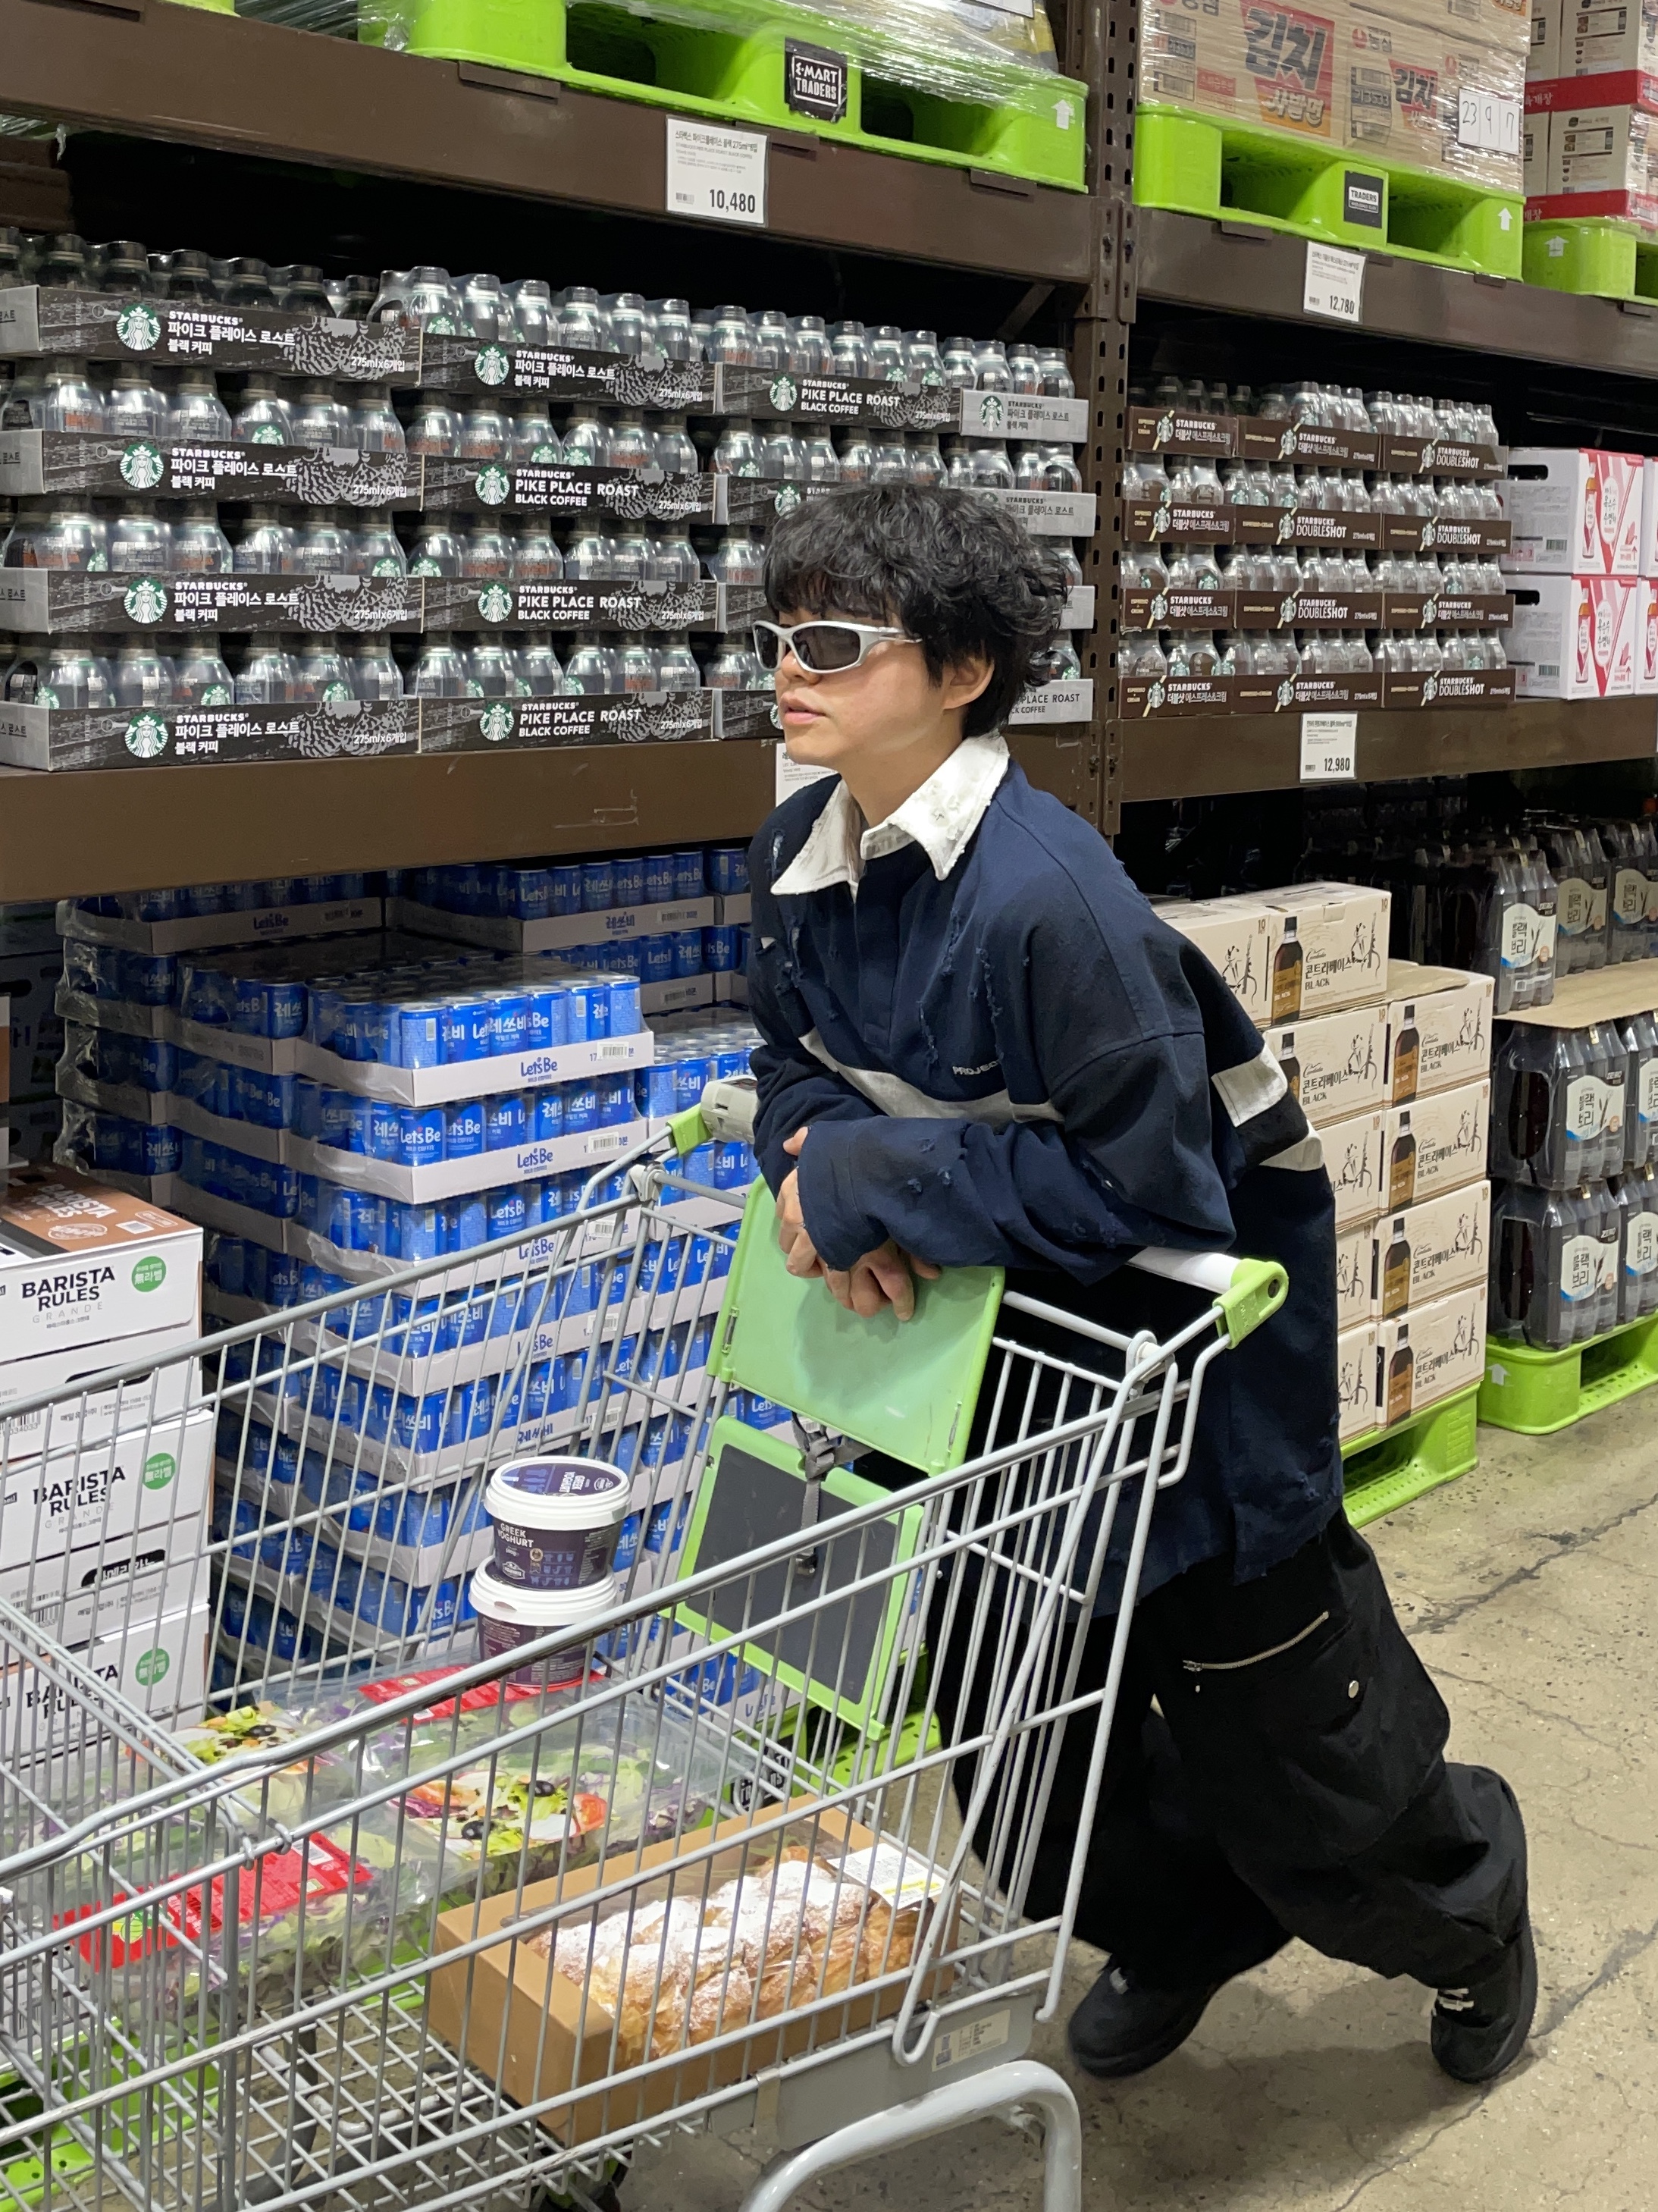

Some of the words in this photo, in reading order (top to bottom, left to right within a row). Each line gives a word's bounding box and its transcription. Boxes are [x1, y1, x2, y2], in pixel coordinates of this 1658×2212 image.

[1246, 8, 1327, 92] 김치
[795, 78, 837, 101] TRADERS
[1393, 68, 1436, 110] 김치
[1263, 89, 1324, 127] 사발면
[1462, 100, 1477, 126] 23
[710, 189, 755, 213] 10,480
[1351, 190, 1377, 202] TRADERS
[1330, 295, 1355, 315] 12,780
[168, 311, 243, 325] STARBUCKS
[168, 322, 206, 337] 파이크
[209, 325, 256, 342] 플레이스
[260, 332, 296, 346] 로스트
[168, 338, 190, 353] 블랙
[191, 341, 212, 355] 커피
[516, 350, 575, 362] STARBUCKS
[515, 360, 544, 374] 파이크
[547, 362, 585, 378] 플레이스
[587, 367, 615, 380] 로스트
[532, 376, 550, 388] 커피
[802, 379, 849, 391] STARBUCKS
[801, 388, 825, 402] PIKE
[829, 391, 863, 405] PLACE
[866, 394, 900, 407] ROAST
[1008, 400, 1045, 409] STARBUCKS
[801, 400, 828, 413] BLACK
[830, 403, 860, 416] COFFEE
[1175, 419, 1215, 430] STARBUCKS
[1299, 433, 1336, 444] STARBUCKS
[171, 448, 246, 460] STARBUCKS
[1437, 447, 1470, 457] STARBUCKS
[171, 458, 208, 474] 파이크
[211, 460, 259, 476] 플레이스
[262, 464, 298, 478] 로스트
[1436, 454, 1479, 469] DOUBLESHOT
[516, 469, 575, 479] STARBUCKS
[171, 475, 193, 489] 블랙
[194, 476, 215, 490] 커피
[516, 480, 546, 492] PIKE
[549, 481, 591, 494] PLACE
[597, 483, 638, 497] ROAST
[516, 494, 548, 505] BLACK
[551, 494, 588, 507] COFFEE
[1173, 510, 1215, 519] STARBUCKS
[1297, 516, 1335, 526] STARBUCKS
[1296, 525, 1346, 538] DOUBLESHOT
[1437, 532, 1481, 544] DOUBLESHOT
[175, 581, 247, 591] STARBUCKS
[519, 585, 578, 595] STARBUCKS
[174, 591, 212, 607] 파이크
[215, 591, 262, 607] 플레이스
[264, 593, 300, 606] 로스트
[518, 595, 549, 608] PIKE
[552, 595, 594, 608] PLACE
[600, 596, 641, 608] ROAST
[1171, 596, 1212, 604] STARBUCKS
[174, 607, 196, 622] 블랙
[197, 607, 218, 622] 커피
[518, 609, 551, 620] BLACK
[553, 610, 591, 620] COFFEE
[1298, 607, 1348, 619] DOUBLESHOT
[1167, 682, 1212, 691] STARBUCKS
[1439, 684, 1484, 696] DOUBLESHOT
[1023, 695, 1048, 704] PLACE
[1052, 693, 1080, 703] ROAST
[522, 702, 579, 711] STARBUCKS
[177, 713, 249, 723] STARBUCKS
[519, 712, 550, 725] PIKE
[553, 711, 595, 723] PLACE
[600, 709, 642, 721] ROAST
[175, 724, 213, 740] 파이크
[216, 723, 262, 739] 플레이스
[265, 721, 300, 734] 로스트
[519, 726, 551, 737] BLACK
[553, 724, 591, 735] COFFEE
[175, 741, 196, 755] 블랙
[198, 739, 218, 753] 커피
[1324, 758, 1350, 773] 12,980
[1305, 957, 1352, 979] 콘트라베이스
[1305, 977, 1330, 990] BLACK
[489, 1015, 527, 1034] 레쓰비
[1420, 1059, 1442, 1072] BLACK
[1302, 1071, 1349, 1094] 콘트라베이스
[1302, 1091, 1327, 1106] BLACK
[1417, 1165, 1439, 1178] BLACK
[21, 1266, 115, 1298] BARISTA
[1412, 1269, 1436, 1285] BLACK
[38, 1286, 99, 1312] RULES
[33, 1301, 103, 1323] GRANDE
[33, 1467, 126, 1504] BARISTA
[50, 1488, 108, 1517] RULES
[497, 1528, 534, 1548] YOGHURT
[500, 1523, 526, 1538] GREEK
